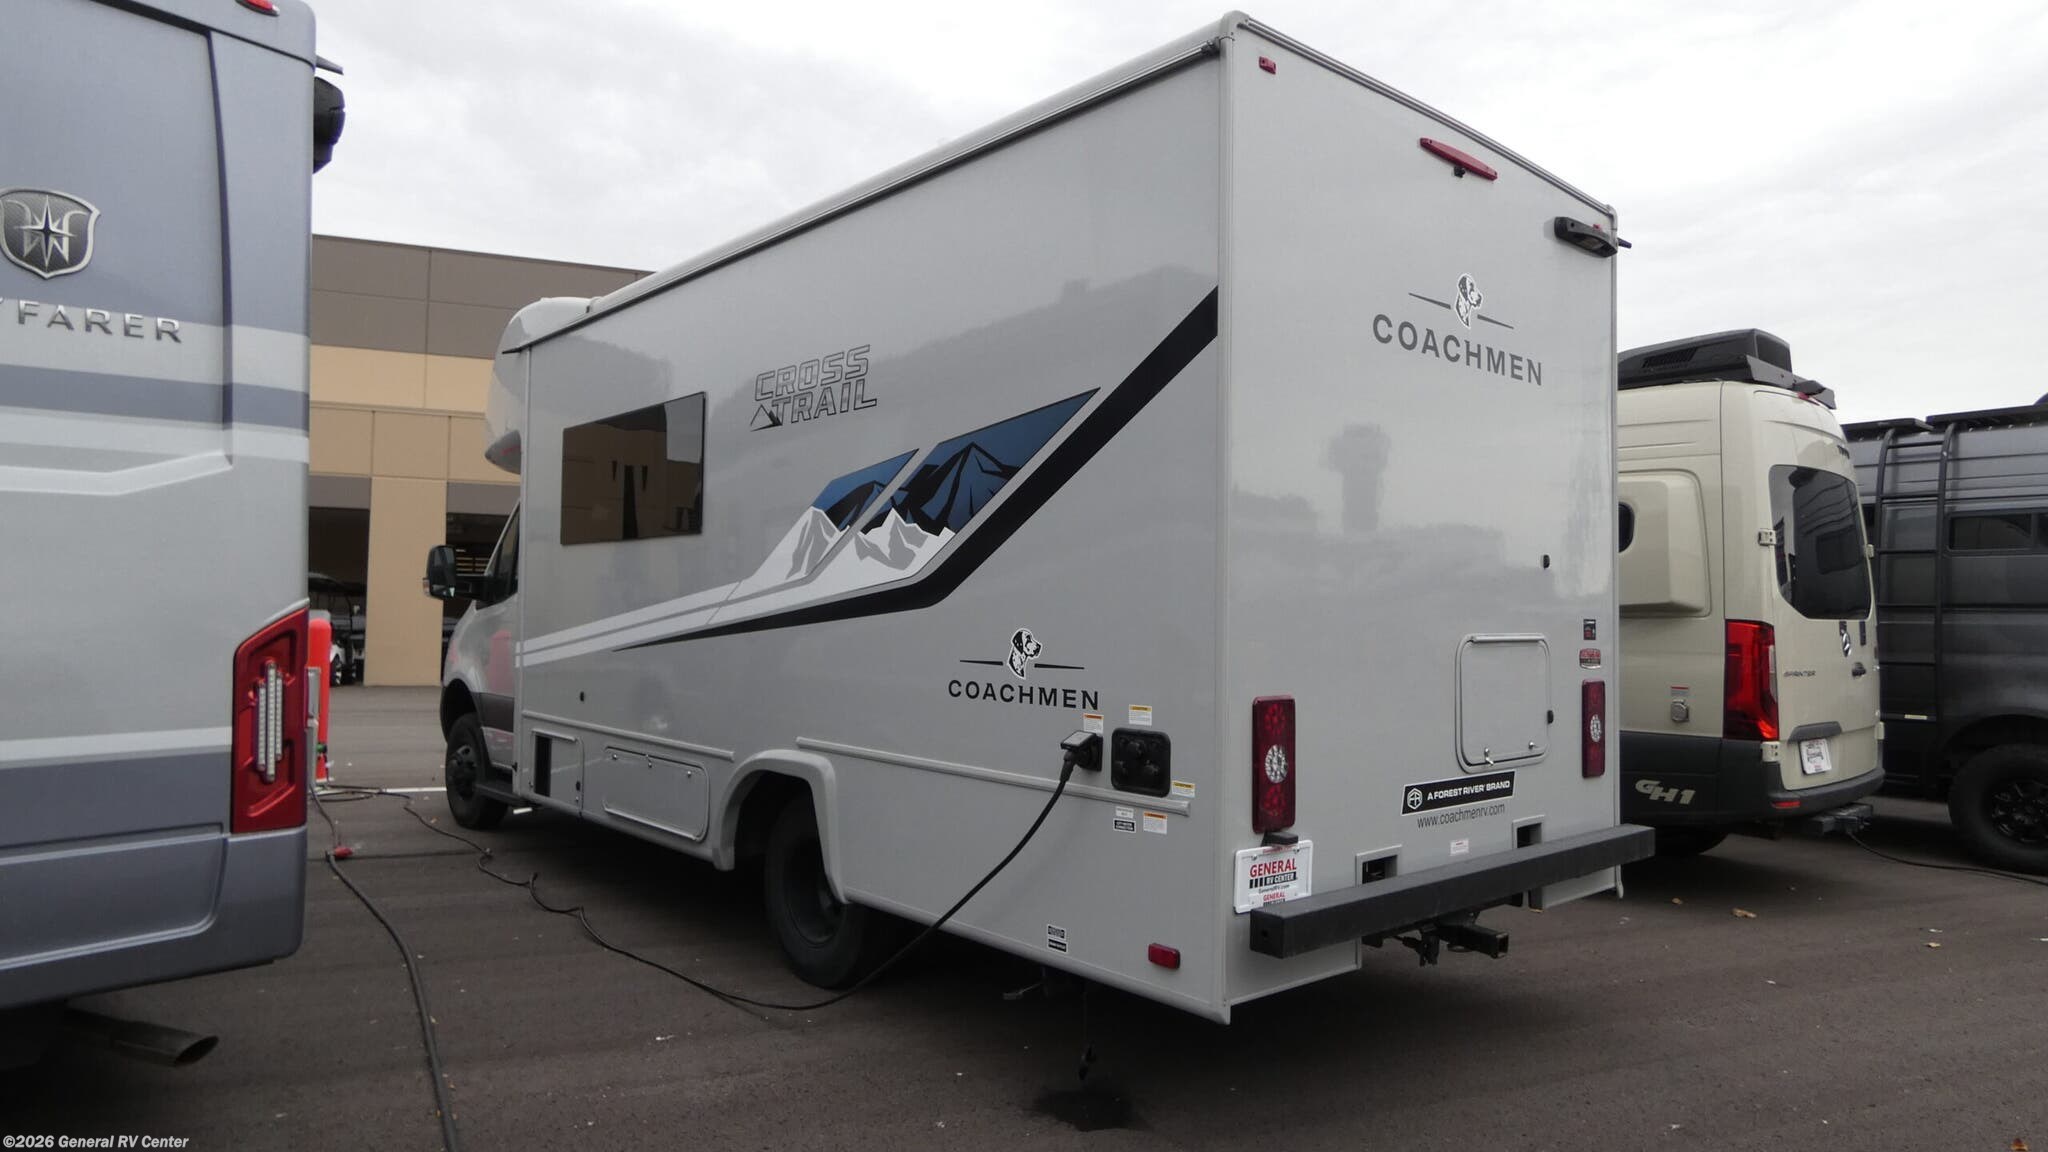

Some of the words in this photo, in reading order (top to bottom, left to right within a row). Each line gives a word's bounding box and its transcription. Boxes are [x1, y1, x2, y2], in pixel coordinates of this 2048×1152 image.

[0, 297, 182, 344] FARER
[1372, 313, 1542, 386] COACHMEN
[754, 344, 871, 402] CROSS
[771, 378, 878, 425] TRAIL
[948, 679, 1099, 711] COACHMEN
[1427, 792, 1434, 800] A
[1434, 787, 1463, 799] FOREST
[1463, 784, 1484, 795] RIVER
[1486, 780, 1511, 792] BRAND
[1635, 779, 1697, 805] GH1
[1417, 803, 1505, 829] www.coachmenrv.com
[1249, 858, 1297, 878] GENERAL
